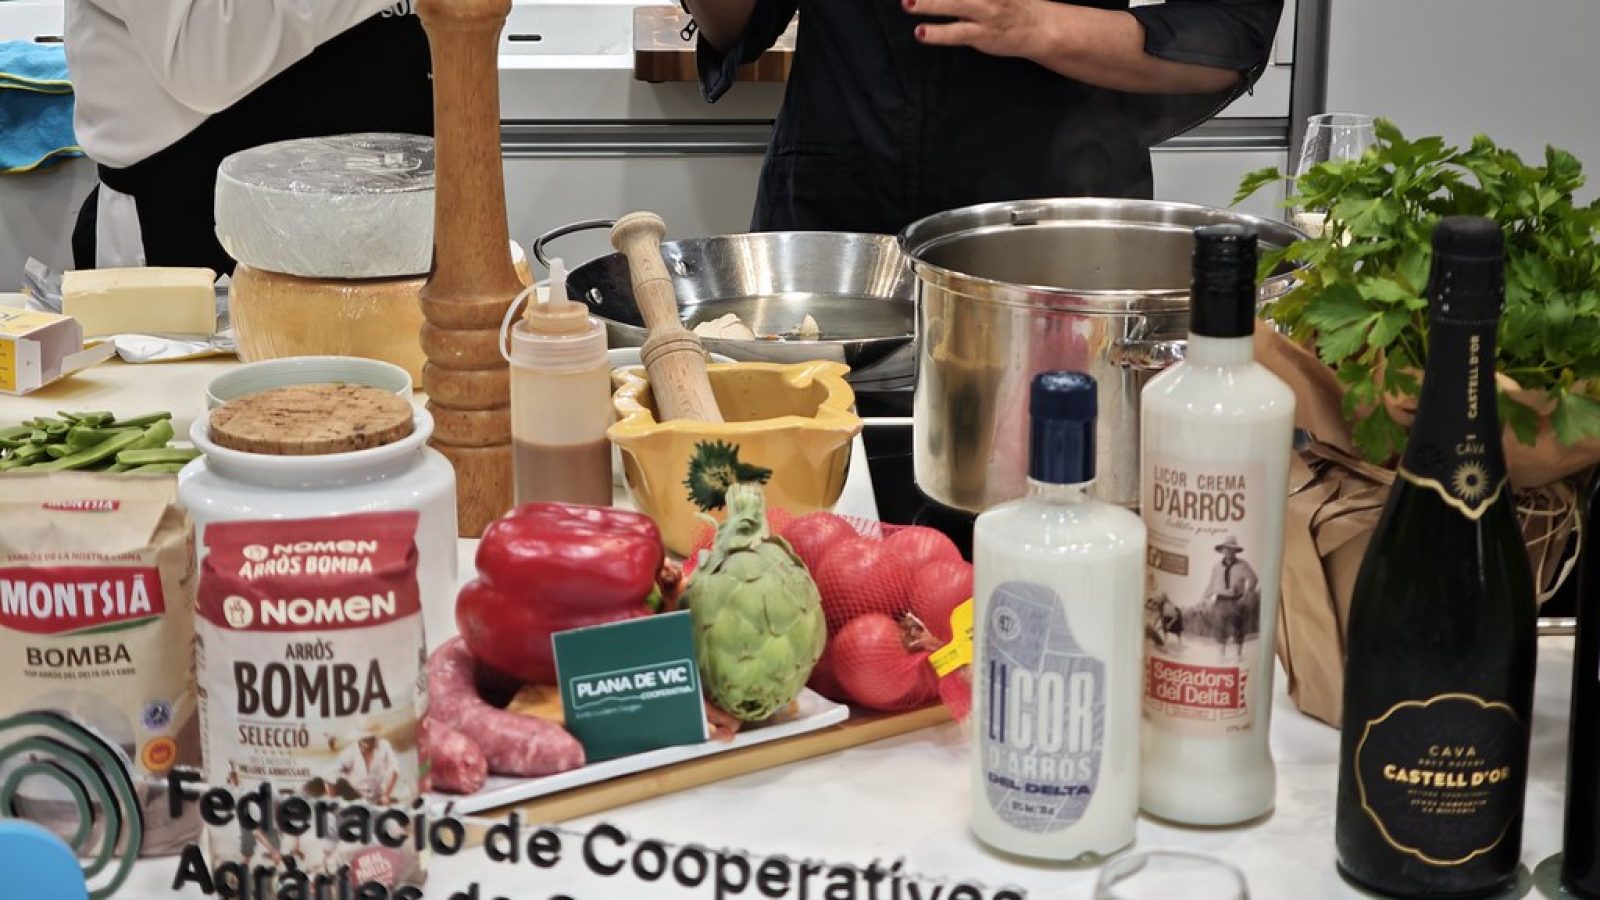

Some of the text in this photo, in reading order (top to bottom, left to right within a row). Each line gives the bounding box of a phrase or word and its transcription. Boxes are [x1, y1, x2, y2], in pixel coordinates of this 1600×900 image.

[1154, 464, 1246, 491] LICOR CREMA
[305, 555, 373, 575] BOMBA
[25, 643, 132, 668] BOMBA
[285, 638, 334, 660] ARRÒS
[576, 666, 688, 698] PLANA DE VIC
[1154, 662, 1235, 688] Segadors
[233, 658, 392, 719] BOMBA
[1157, 684, 1230, 705] del Delta
[989, 660, 1096, 754] LICOR
[238, 723, 309, 748] SELECCIÓ
[1428, 745, 1477, 757] CAVA
[988, 771, 1091, 795] DEL DELTA
[1383, 763, 1468, 787] CASTELL
[168, 772, 465, 856] Federació
[485, 811, 562, 869] de
